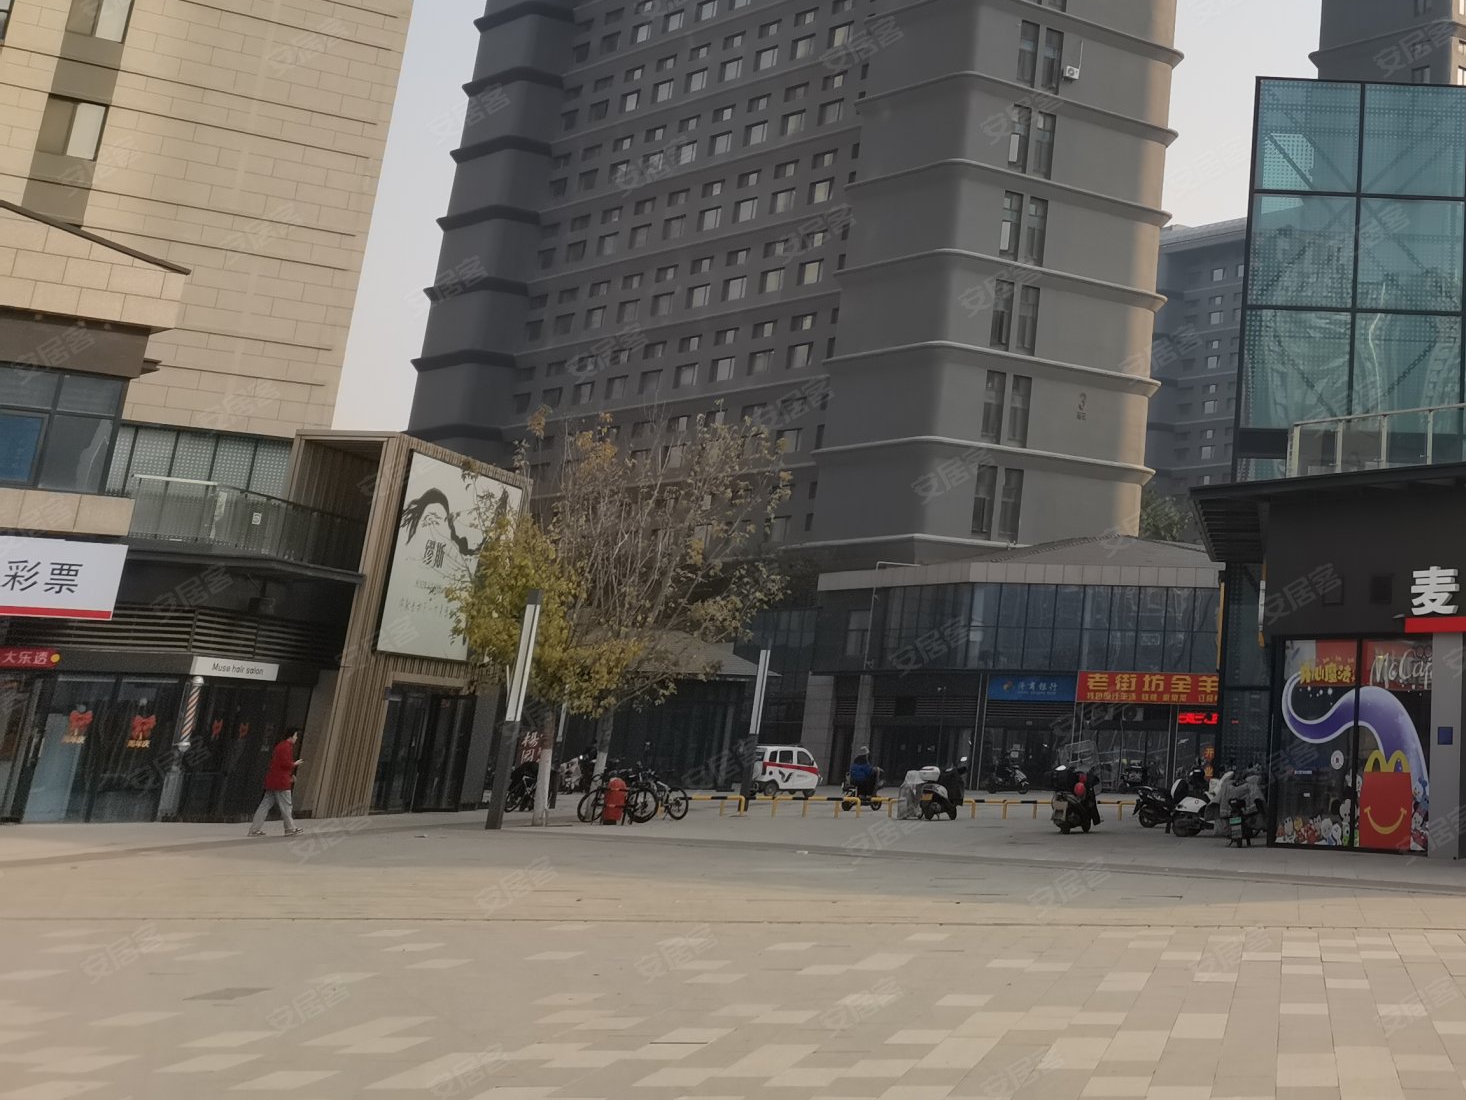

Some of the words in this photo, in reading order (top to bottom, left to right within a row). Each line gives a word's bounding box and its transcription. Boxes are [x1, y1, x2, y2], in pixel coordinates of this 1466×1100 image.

[1, 559, 83, 595] 彩票
[2, 650, 49, 666] 大乐透
[212, 662, 231, 672] Muse
[232, 664, 245, 673] hair
[246, 667, 264, 675] salon
[1369, 649, 1433, 690] McCaf
[1087, 673, 1219, 693] 老街坊全羊
